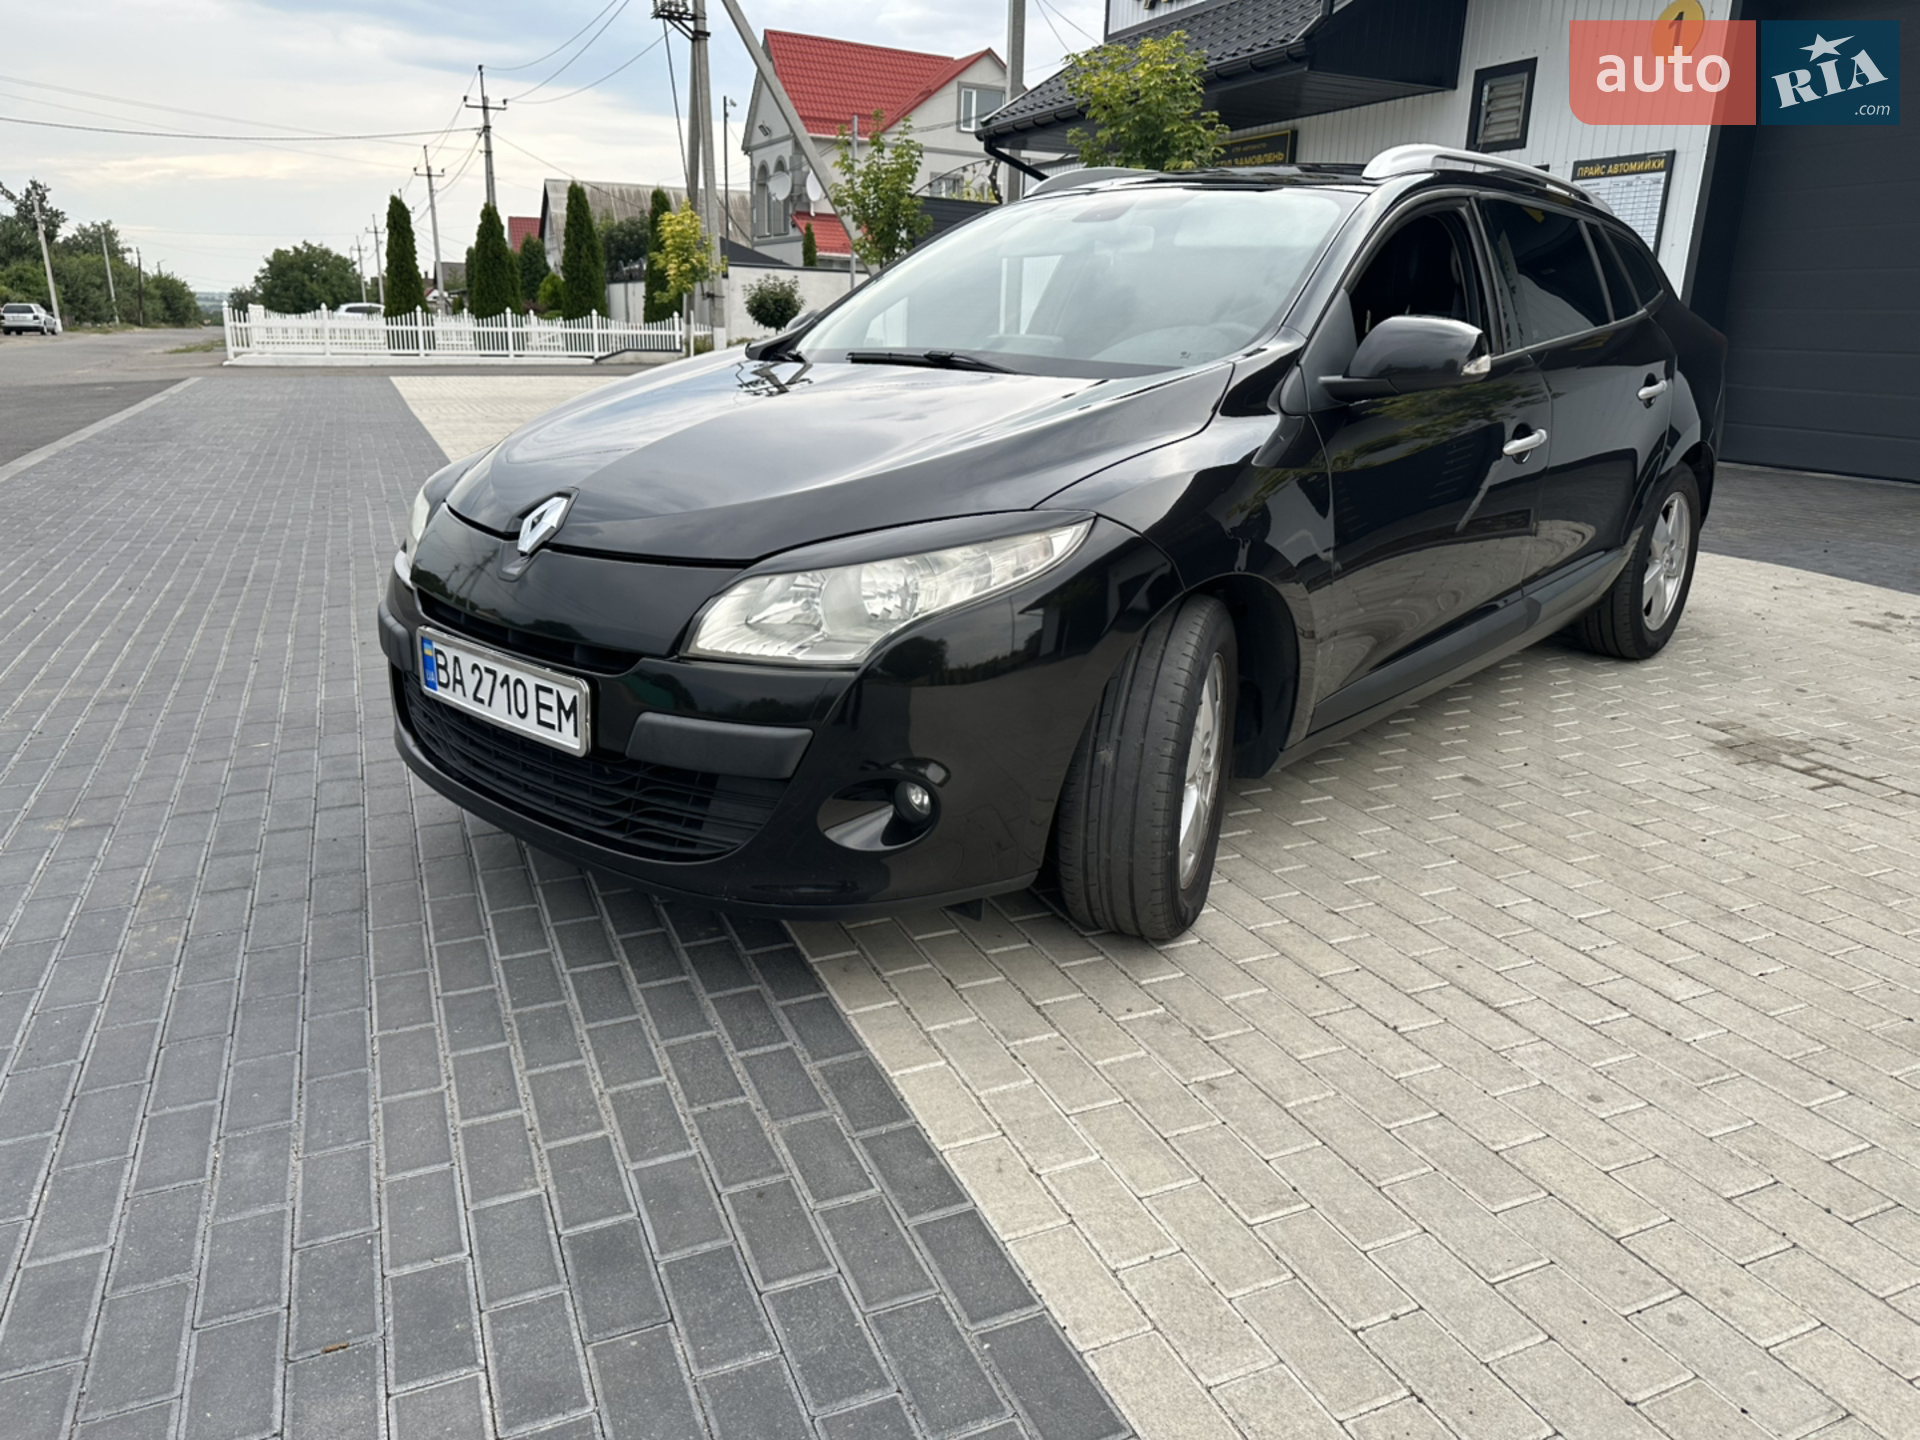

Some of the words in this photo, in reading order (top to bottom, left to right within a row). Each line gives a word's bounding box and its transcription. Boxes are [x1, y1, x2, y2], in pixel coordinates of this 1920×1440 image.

[1234, 151, 1285, 166] ЗАМОВЛЕНЬ
[1576, 163, 1607, 177] ПРАЙС
[1607, 158, 1665, 175] АВТОМИЙКИ
[434, 647, 467, 698] BA
[471, 662, 529, 720] 2710
[534, 683, 578, 738] EM
